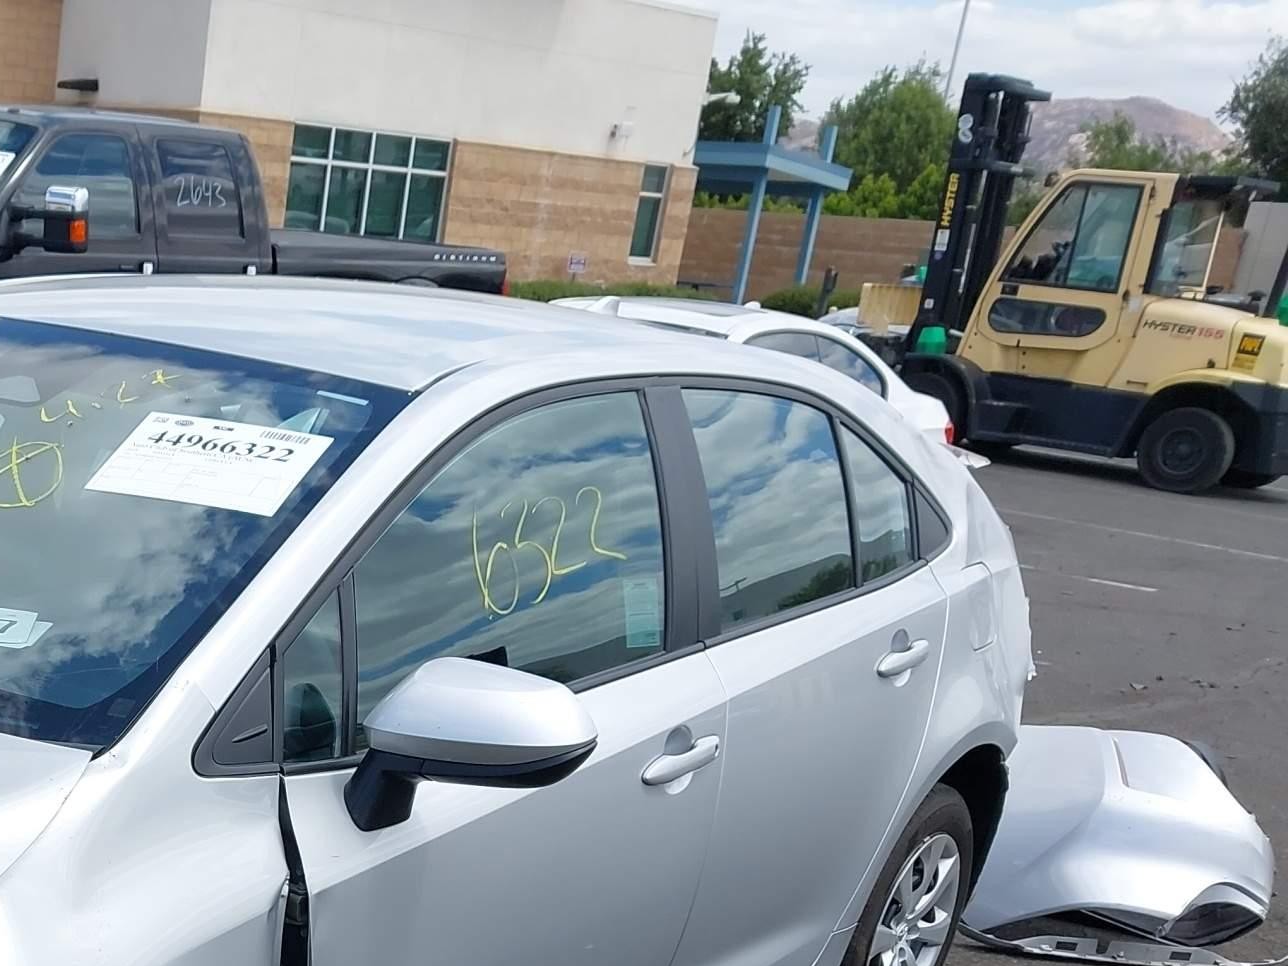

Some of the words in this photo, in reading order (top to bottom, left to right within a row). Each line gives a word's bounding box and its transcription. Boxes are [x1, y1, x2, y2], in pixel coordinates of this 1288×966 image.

[174, 176, 226, 207] 2643
[940, 172, 961, 227] HYSTER
[1142, 319, 1197, 336] HYSTER
[147, 429, 296, 464] 44966322
